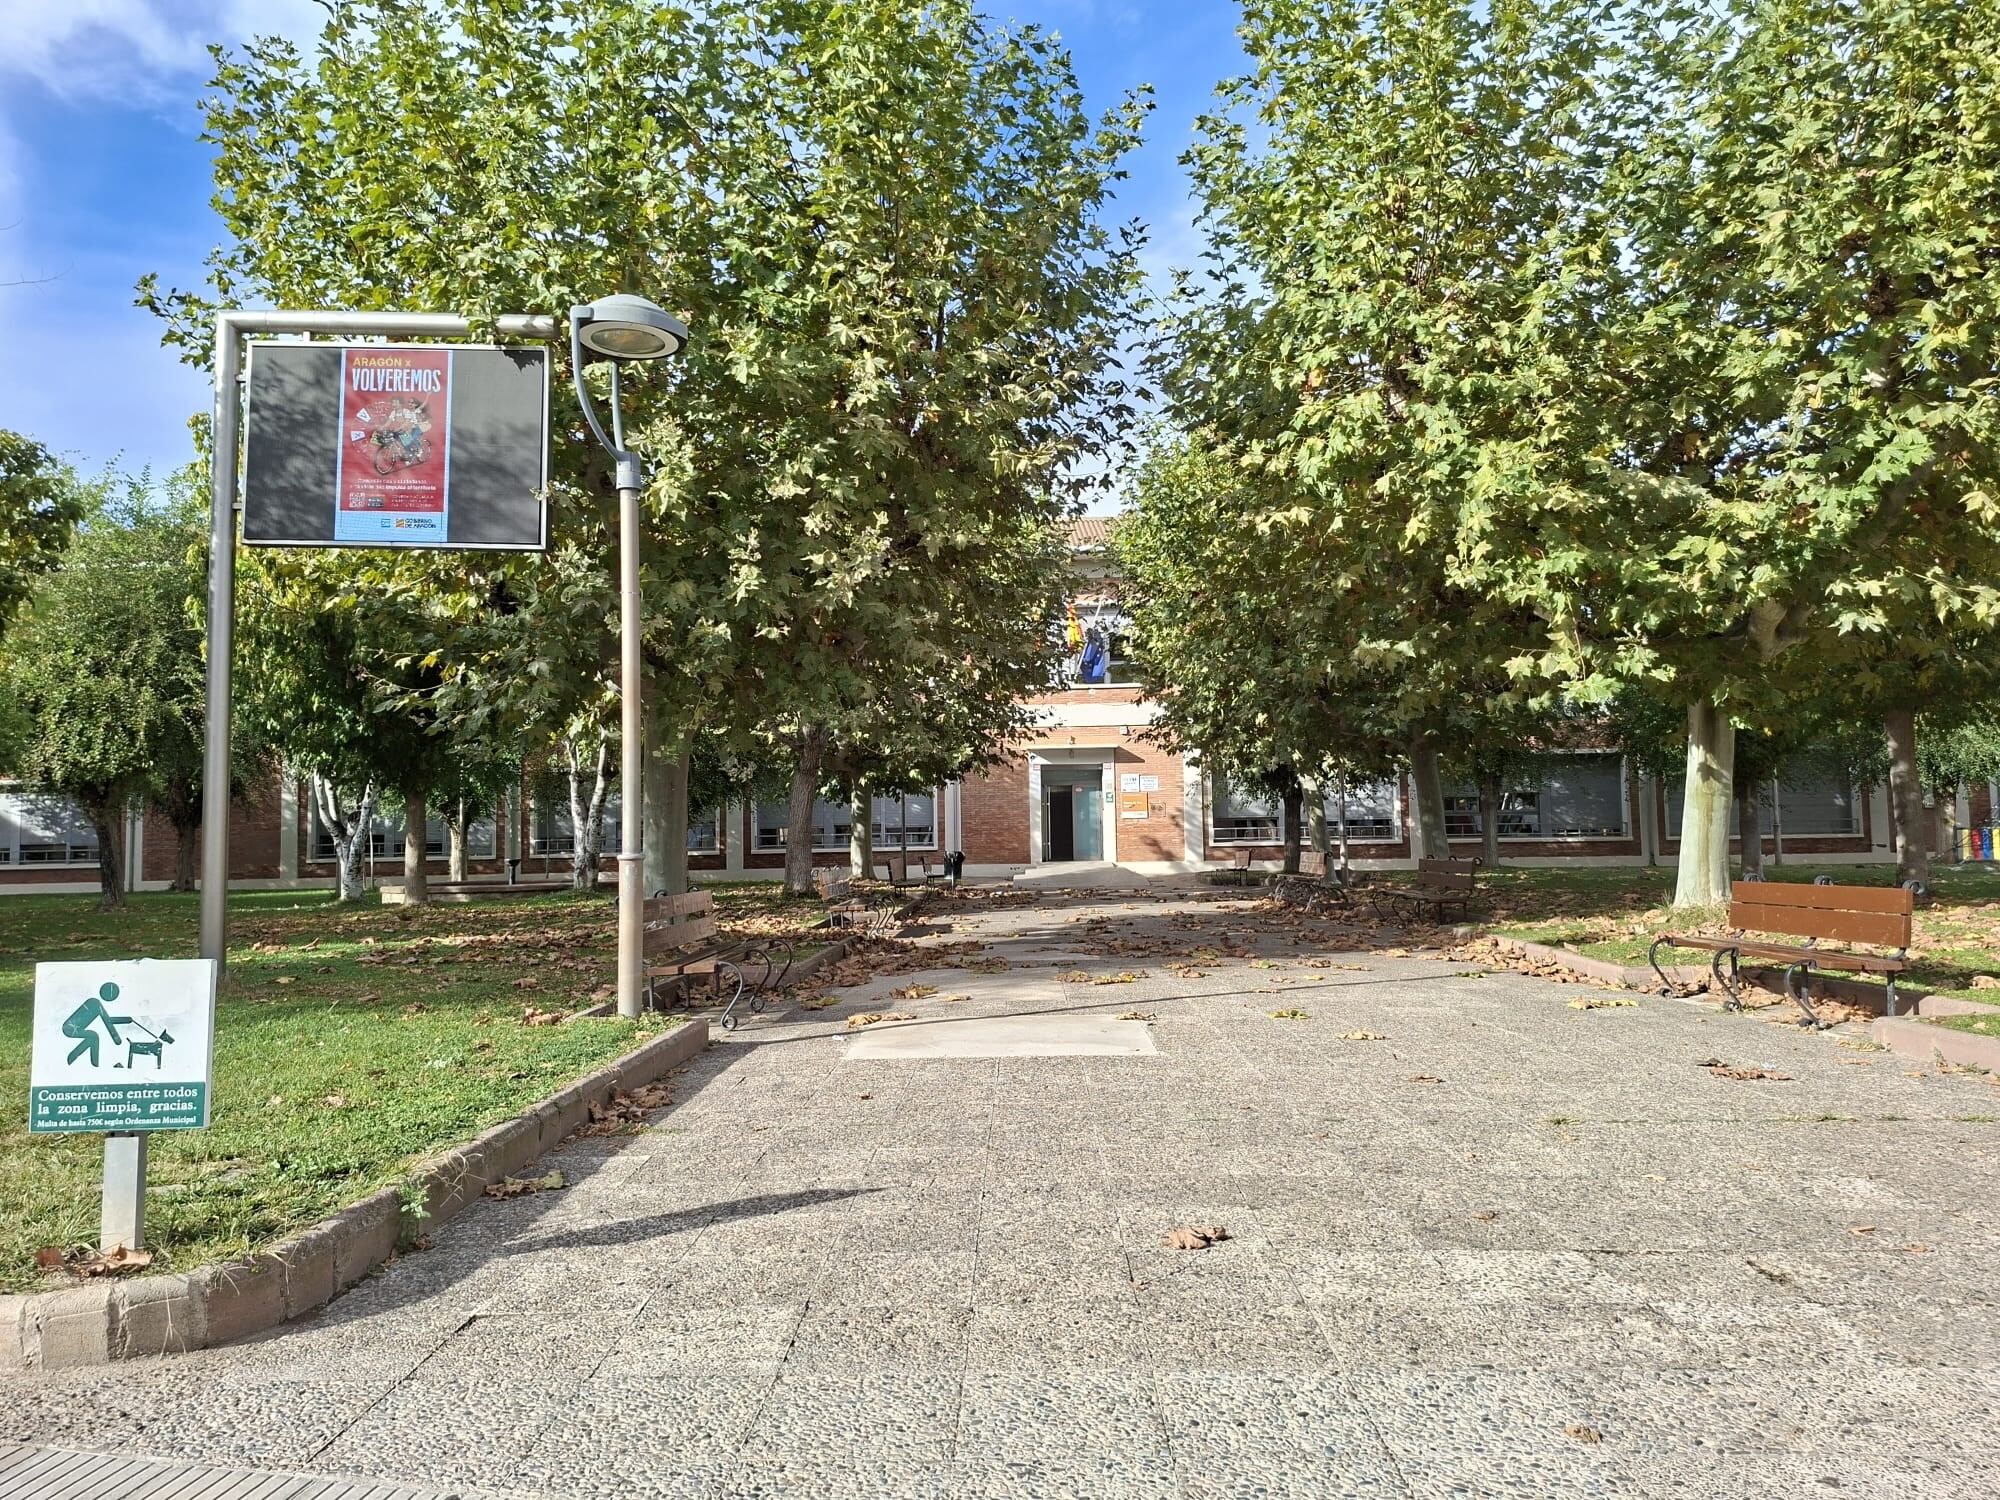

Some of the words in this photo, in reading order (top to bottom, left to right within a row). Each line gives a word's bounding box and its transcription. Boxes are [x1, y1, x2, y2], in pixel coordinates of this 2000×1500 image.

[353, 356, 402, 367] ARAGÓN
[352, 368, 441, 392] VOLVEREMOS
[38, 1089, 123, 1101] Conservemos
[126, 1089, 160, 1099] entre
[163, 1086, 198, 1098] todos
[37, 1103, 50, 1115] la
[57, 1105, 88, 1114] zona
[95, 1100, 142, 1115] limpia,
[149, 1099, 197, 1114] gracias.
[37, 1119, 58, 1128] Multa
[59, 1119, 68, 1127] de
[69, 1118, 86, 1126] hasta
[87, 1117, 103, 1126] 750€
[104, 1117, 123, 1127] según
[125, 1116, 161, 1125] Ordenanza
[162, 1115, 197, 1125] Municipal
